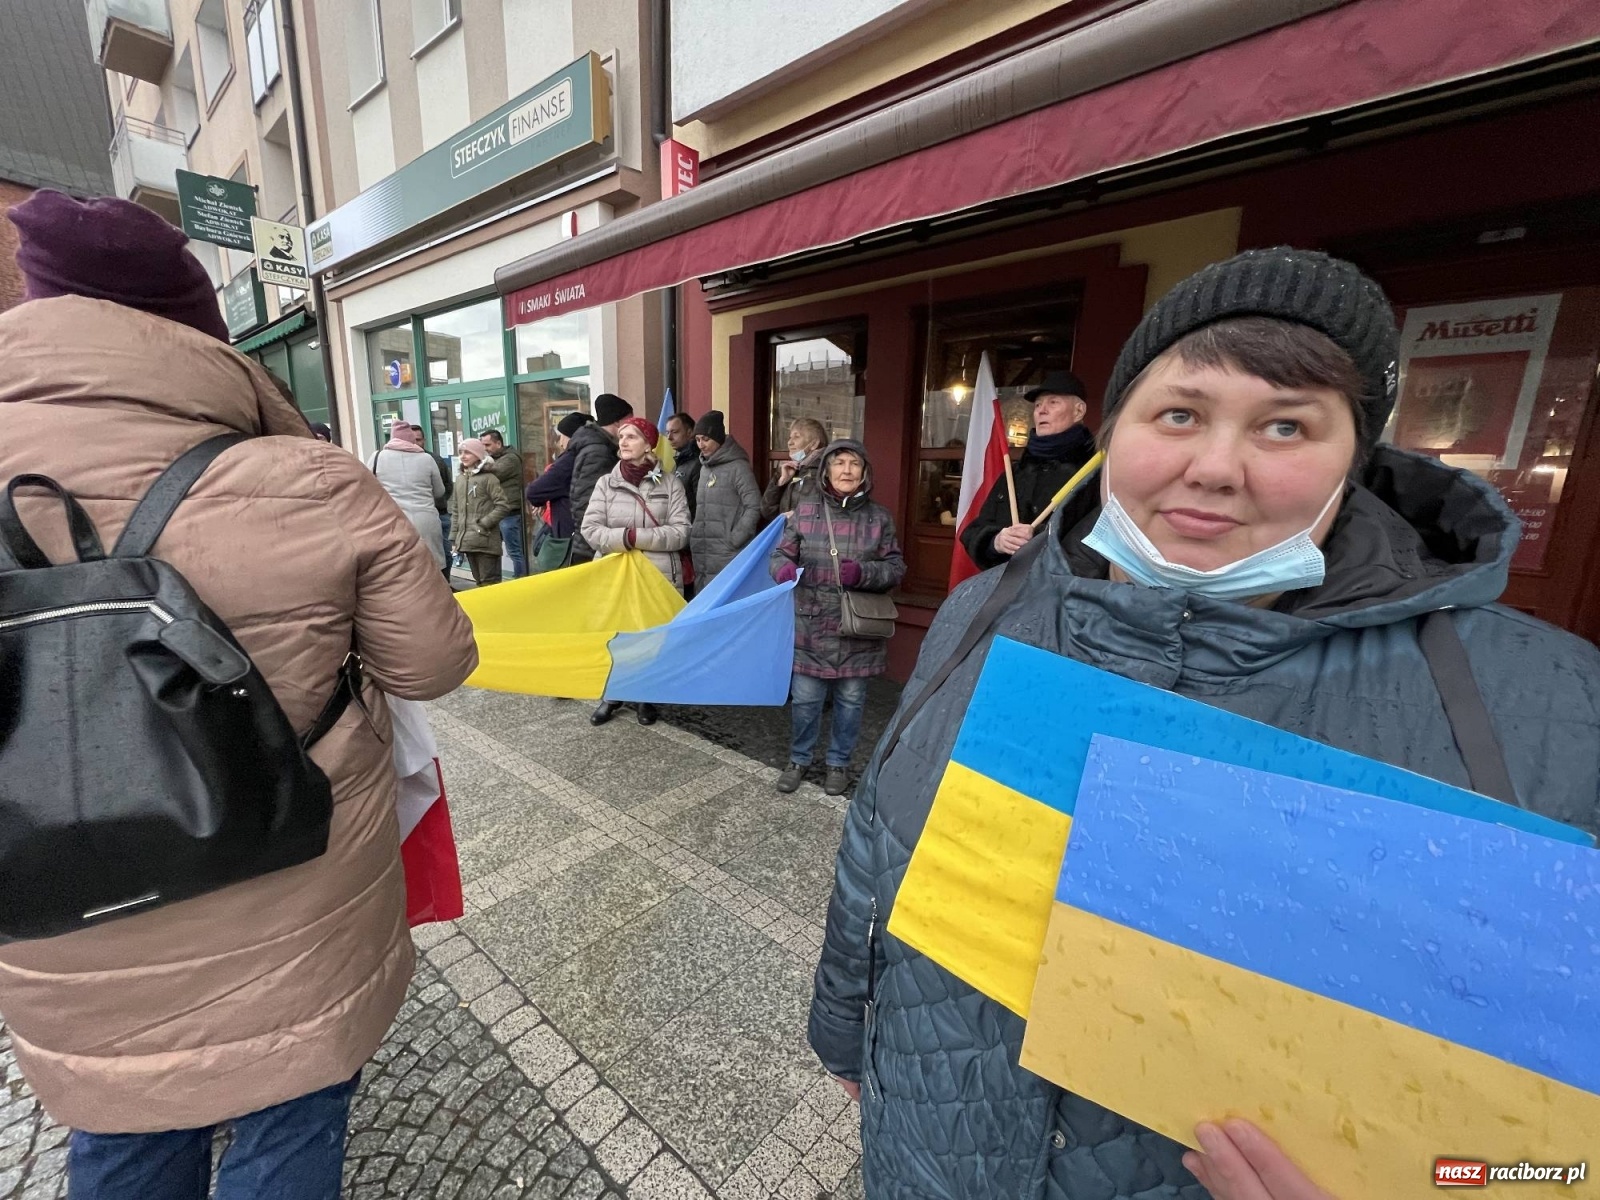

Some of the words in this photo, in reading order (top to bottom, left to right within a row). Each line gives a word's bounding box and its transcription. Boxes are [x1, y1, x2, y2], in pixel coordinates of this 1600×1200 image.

[454, 123, 506, 169] STEFCZYK
[511, 91, 567, 139] FINANSE
[203, 204, 237, 216] ADWOKAT
[204, 219, 239, 230] ADWOKAT
[207, 233, 241, 245] ADWOKAT
[316, 226, 331, 244] KASA
[275, 263, 303, 275] KASY
[263, 271, 305, 286] STEFCZYKA
[527, 293, 551, 313] SMAKI
[554, 283, 586, 306] ŚWIATA
[1415, 308, 1539, 342] Musetti
[471, 411, 501, 432] GRAMY
